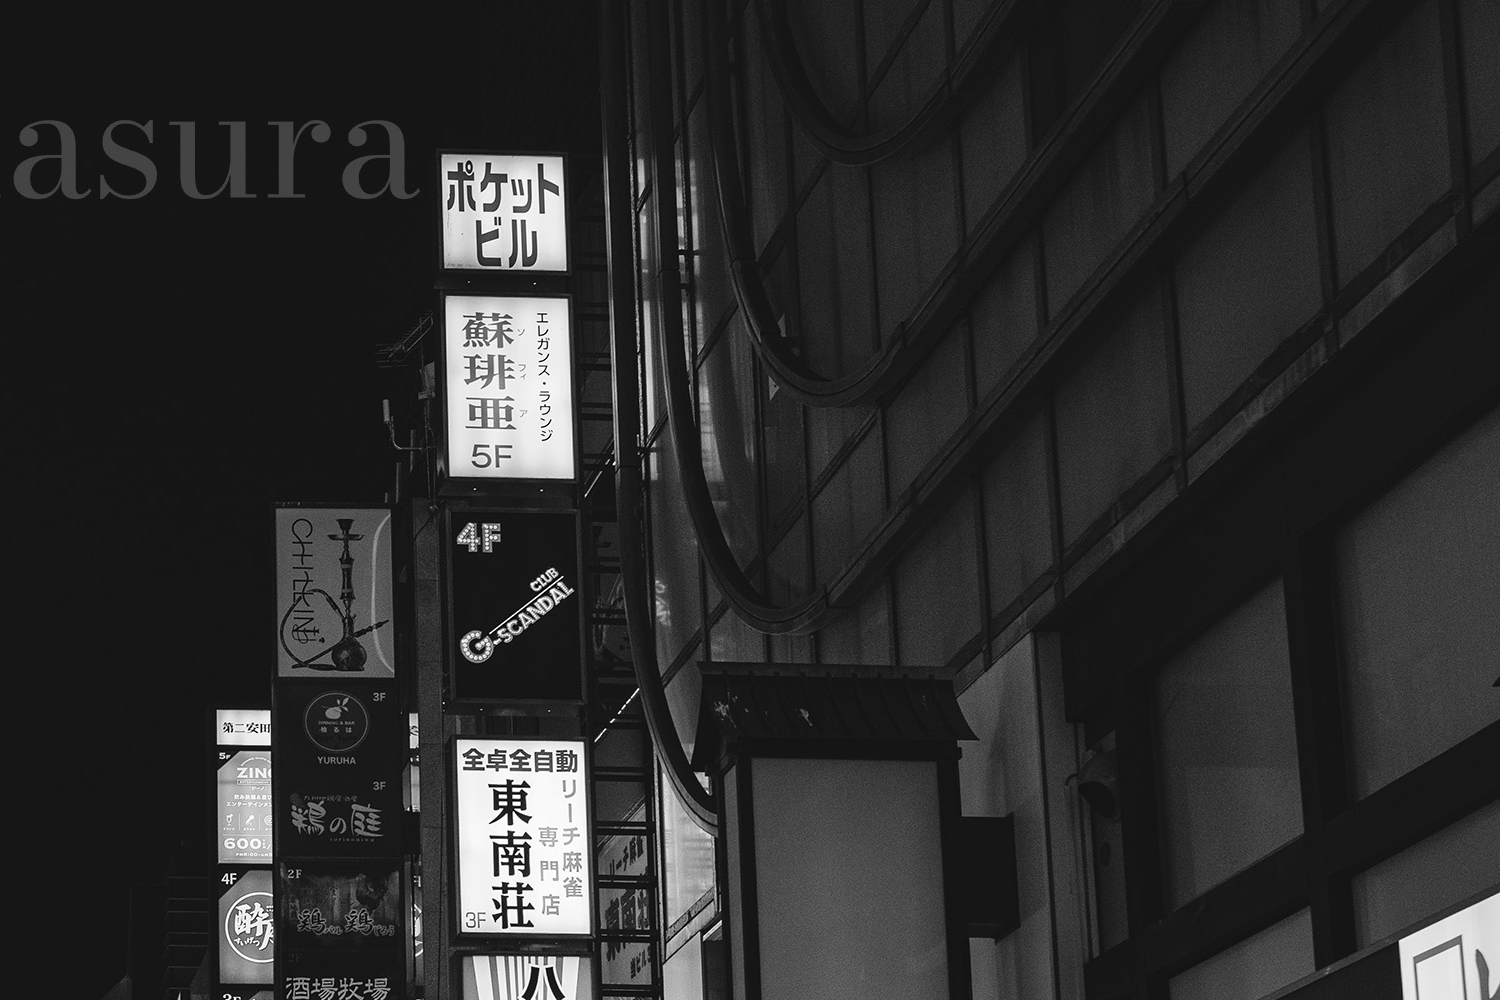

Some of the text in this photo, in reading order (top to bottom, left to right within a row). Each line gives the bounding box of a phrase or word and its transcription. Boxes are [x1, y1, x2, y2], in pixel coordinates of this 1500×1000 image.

[447, 160, 559, 214] ポケット
[476, 216, 537, 268] ビル
[471, 444, 513, 469] 5F
[457, 522, 501, 553] 4F
[530, 567, 560, 593] CLUB
[373, 693, 386, 702] 3F
[219, 752, 231, 760] 5F
[317, 756, 356, 765] YURUHA
[462, 748, 578, 773] 全卓全自動
[373, 781, 386, 790] 3F
[562, 780, 584, 899] リーチ麻雀
[488, 779, 535, 930] 東南荘
[221, 873, 237, 884] 4F
[288, 869, 302, 879] 2F
[538, 827, 561, 916] 専門店
[466, 912, 486, 929] 3F
[286, 977, 391, 1000] 酒場牧場
